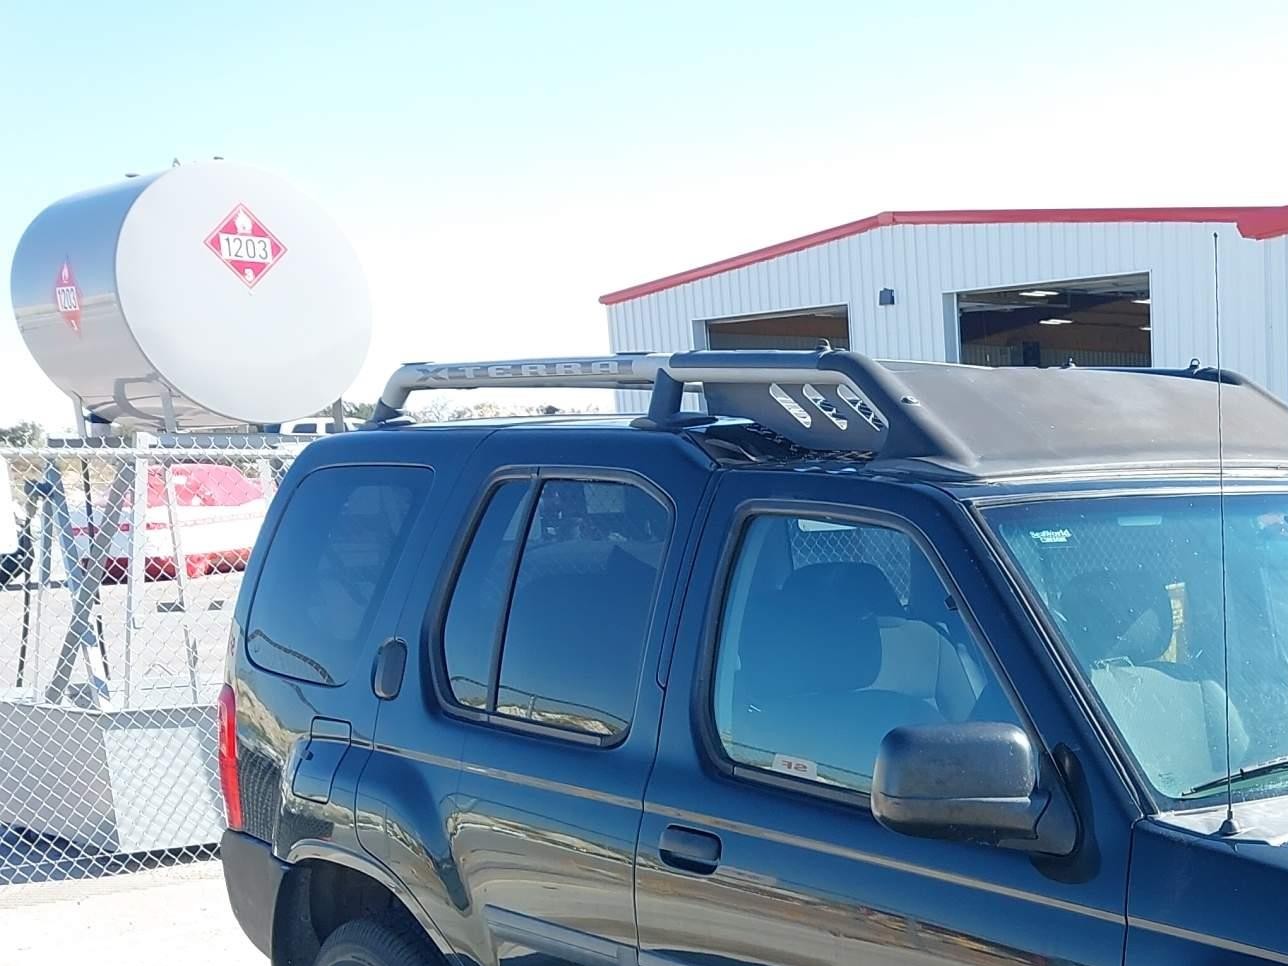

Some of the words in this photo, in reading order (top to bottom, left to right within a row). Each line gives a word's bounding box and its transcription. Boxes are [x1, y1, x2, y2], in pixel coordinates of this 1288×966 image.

[223, 236, 269, 261] 1203
[243, 266, 256, 283] 3
[415, 361, 620, 383] XTERRA
